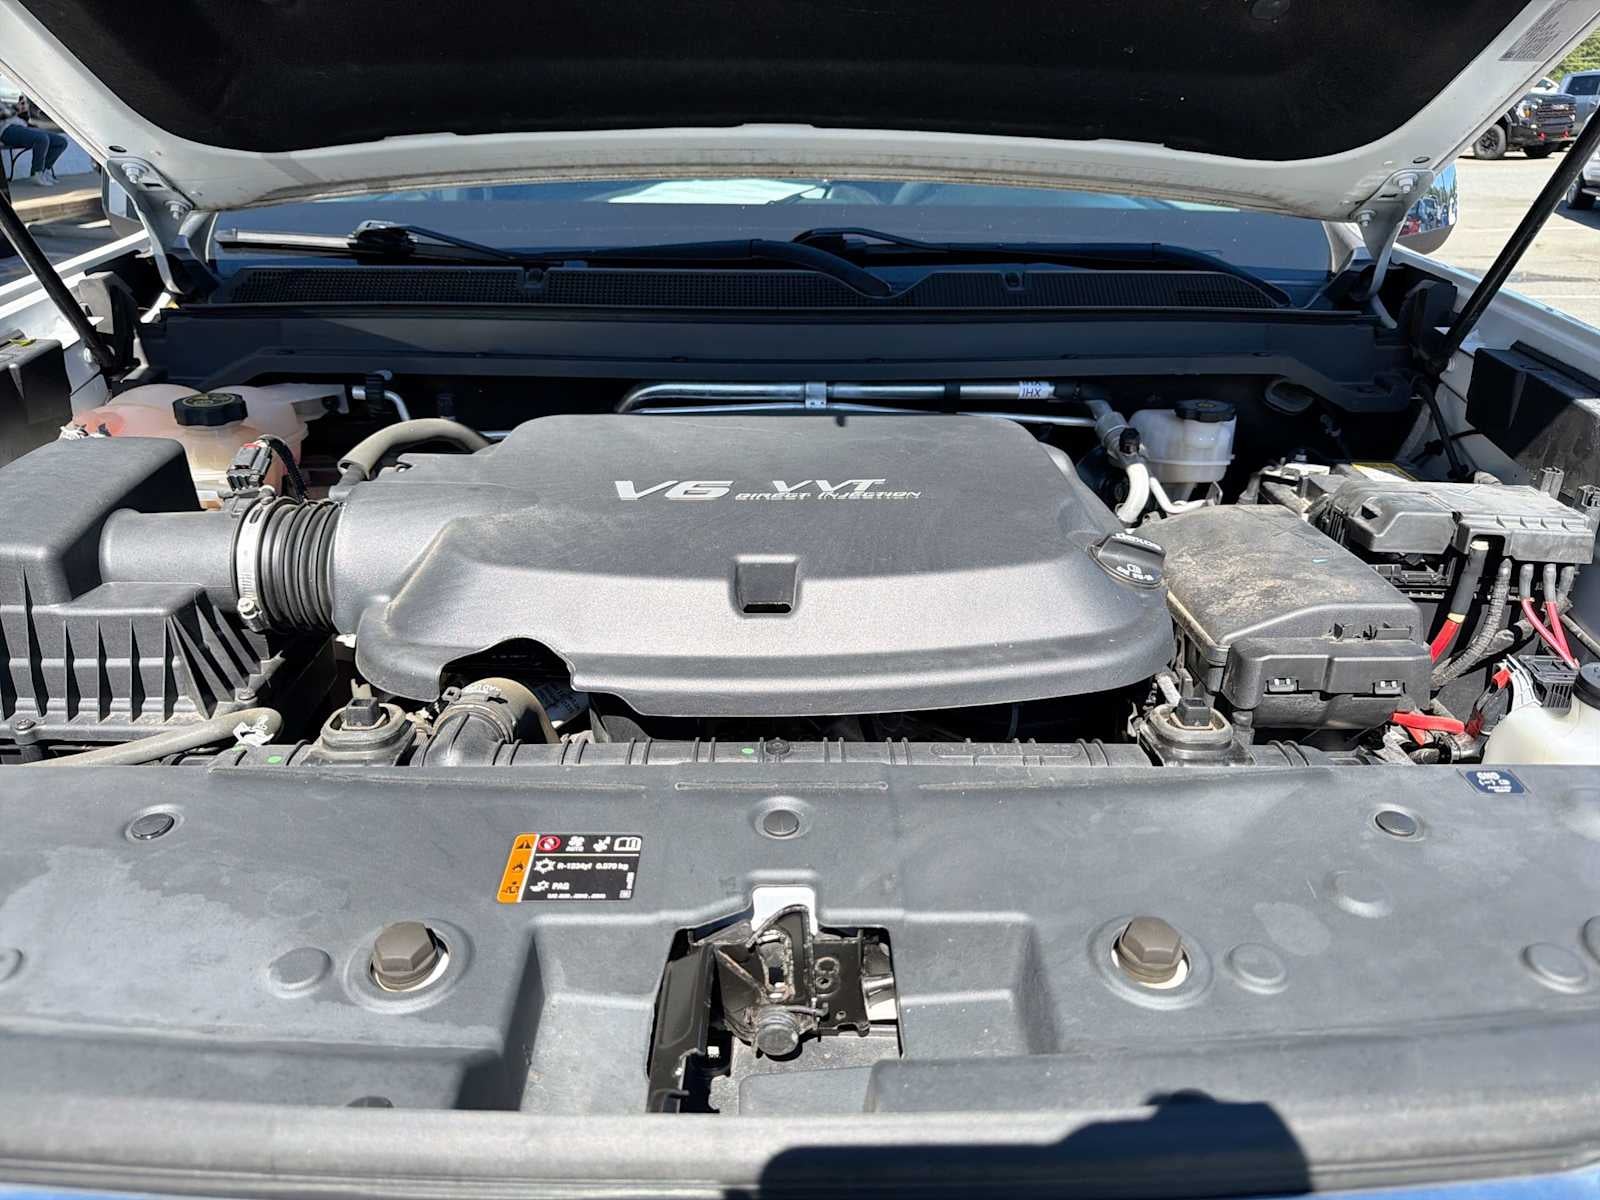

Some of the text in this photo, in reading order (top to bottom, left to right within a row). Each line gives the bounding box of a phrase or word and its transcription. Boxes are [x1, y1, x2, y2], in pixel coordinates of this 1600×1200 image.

[615, 479, 886, 500] V6 VVT
[735, 491, 922, 500] DIRECT INJECTION
